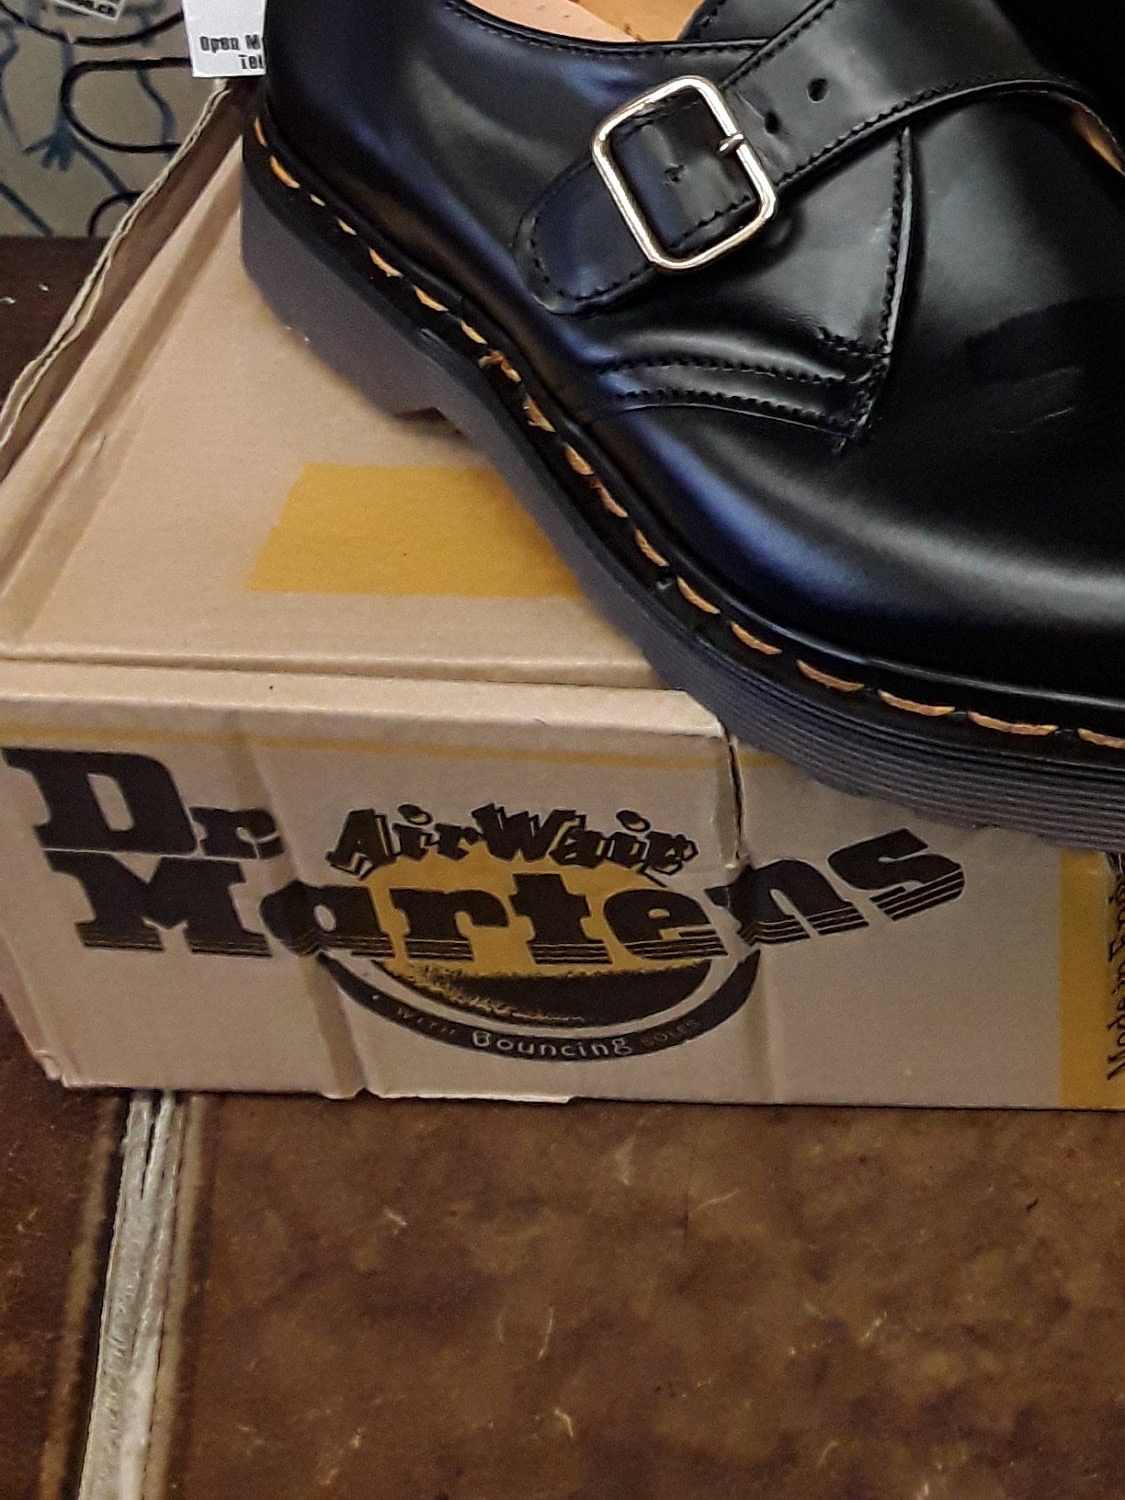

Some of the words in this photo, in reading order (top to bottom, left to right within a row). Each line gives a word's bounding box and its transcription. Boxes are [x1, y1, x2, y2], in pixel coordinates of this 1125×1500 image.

[200, 36, 240, 53] Open
[327, 804, 698, 876] AirWair
[45, 828, 966, 965] Martens
[472, 1030, 632, 1059] Bouncing
